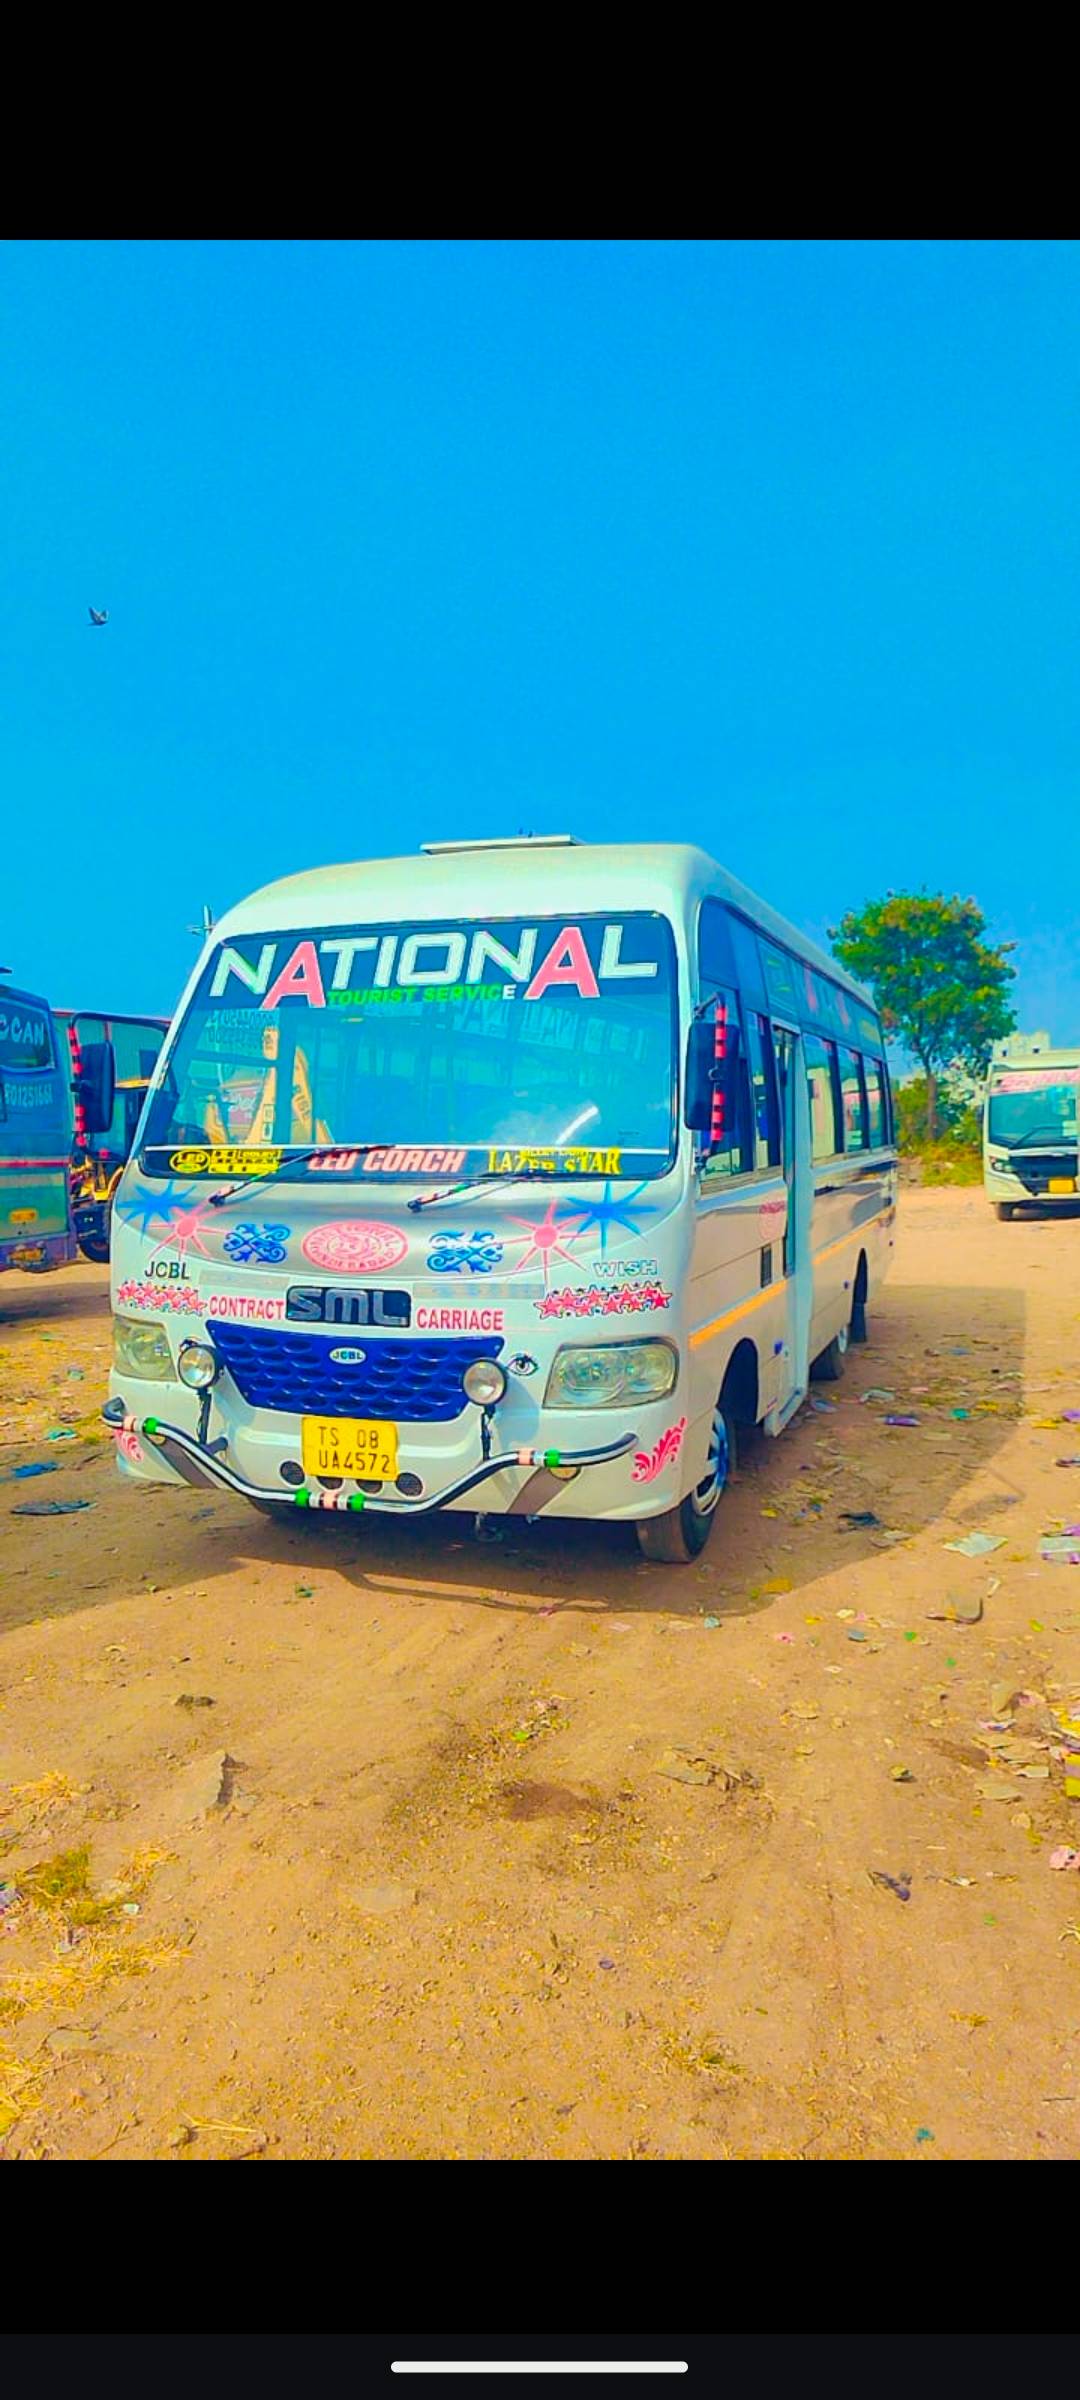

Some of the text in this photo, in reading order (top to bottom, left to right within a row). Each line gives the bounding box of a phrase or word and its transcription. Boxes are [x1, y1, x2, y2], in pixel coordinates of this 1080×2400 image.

[209, 925, 658, 1009] NATIONAL
[327, 984, 516, 1005] TOURIST SERVICE
[362, 1149, 467, 1173] COACH
[144, 1261, 190, 1280] JCBL
[593, 1259, 658, 1278] WISH
[209, 1296, 504, 1331] CONTRACT CARRIAGE
[331, 1350, 364, 1360] JCBL
[318, 1426, 379, 1449] TS 08
[318, 1449, 390, 1473] UA4572
